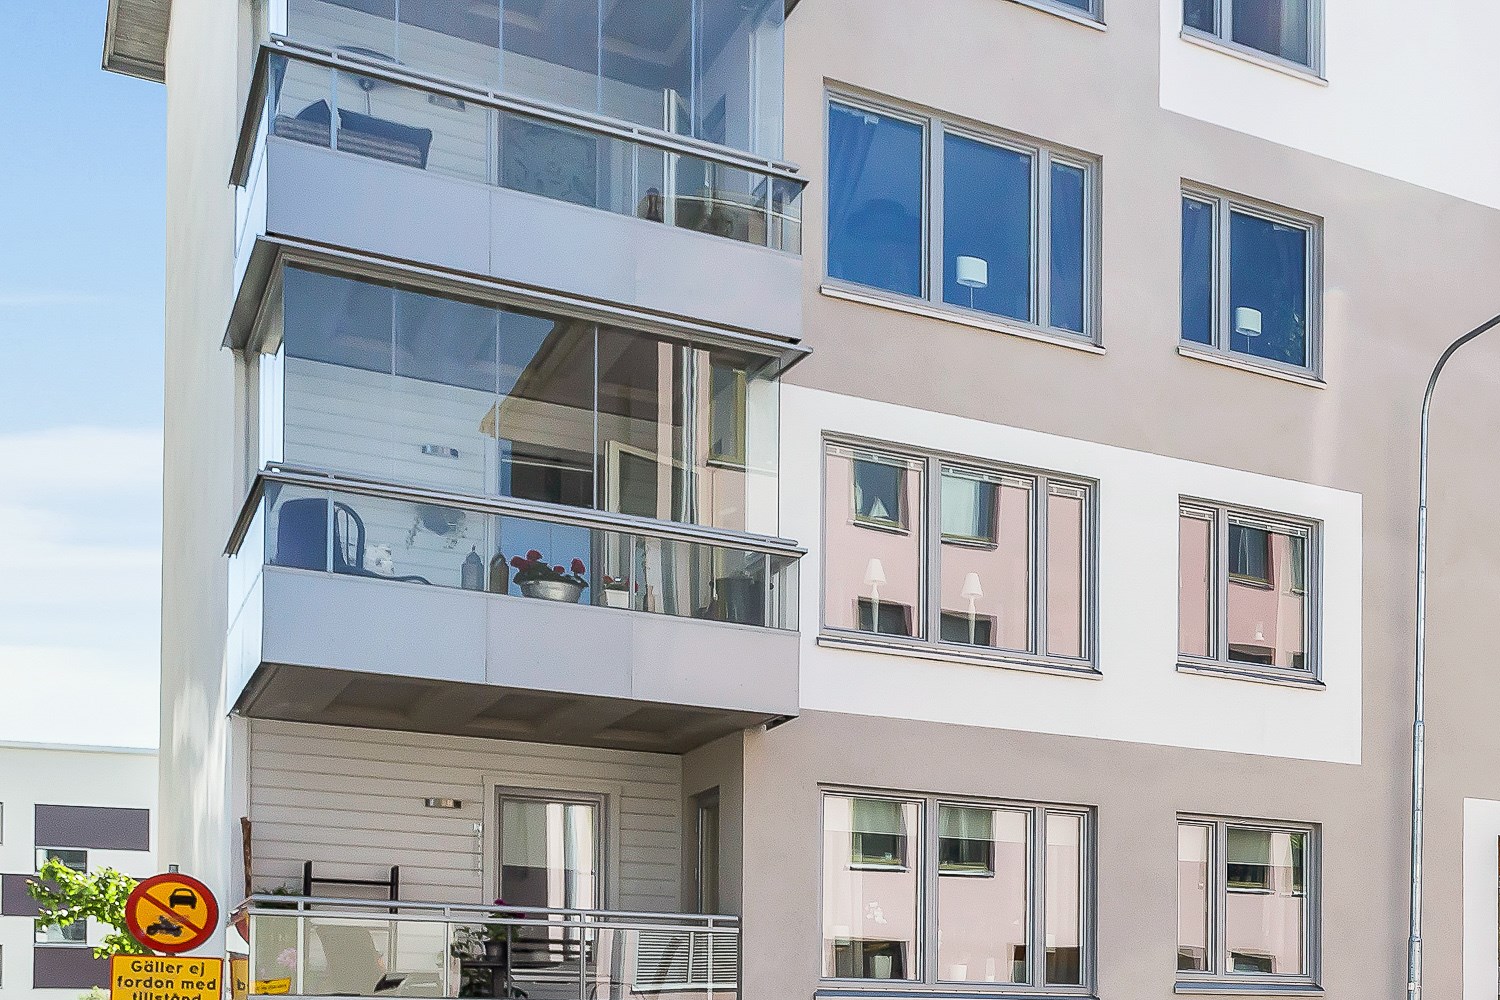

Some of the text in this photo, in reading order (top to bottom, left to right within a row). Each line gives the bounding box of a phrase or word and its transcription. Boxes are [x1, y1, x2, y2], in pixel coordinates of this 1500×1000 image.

[131, 960, 205, 977] Gäller ej
[117, 976, 217, 990] fordon med
